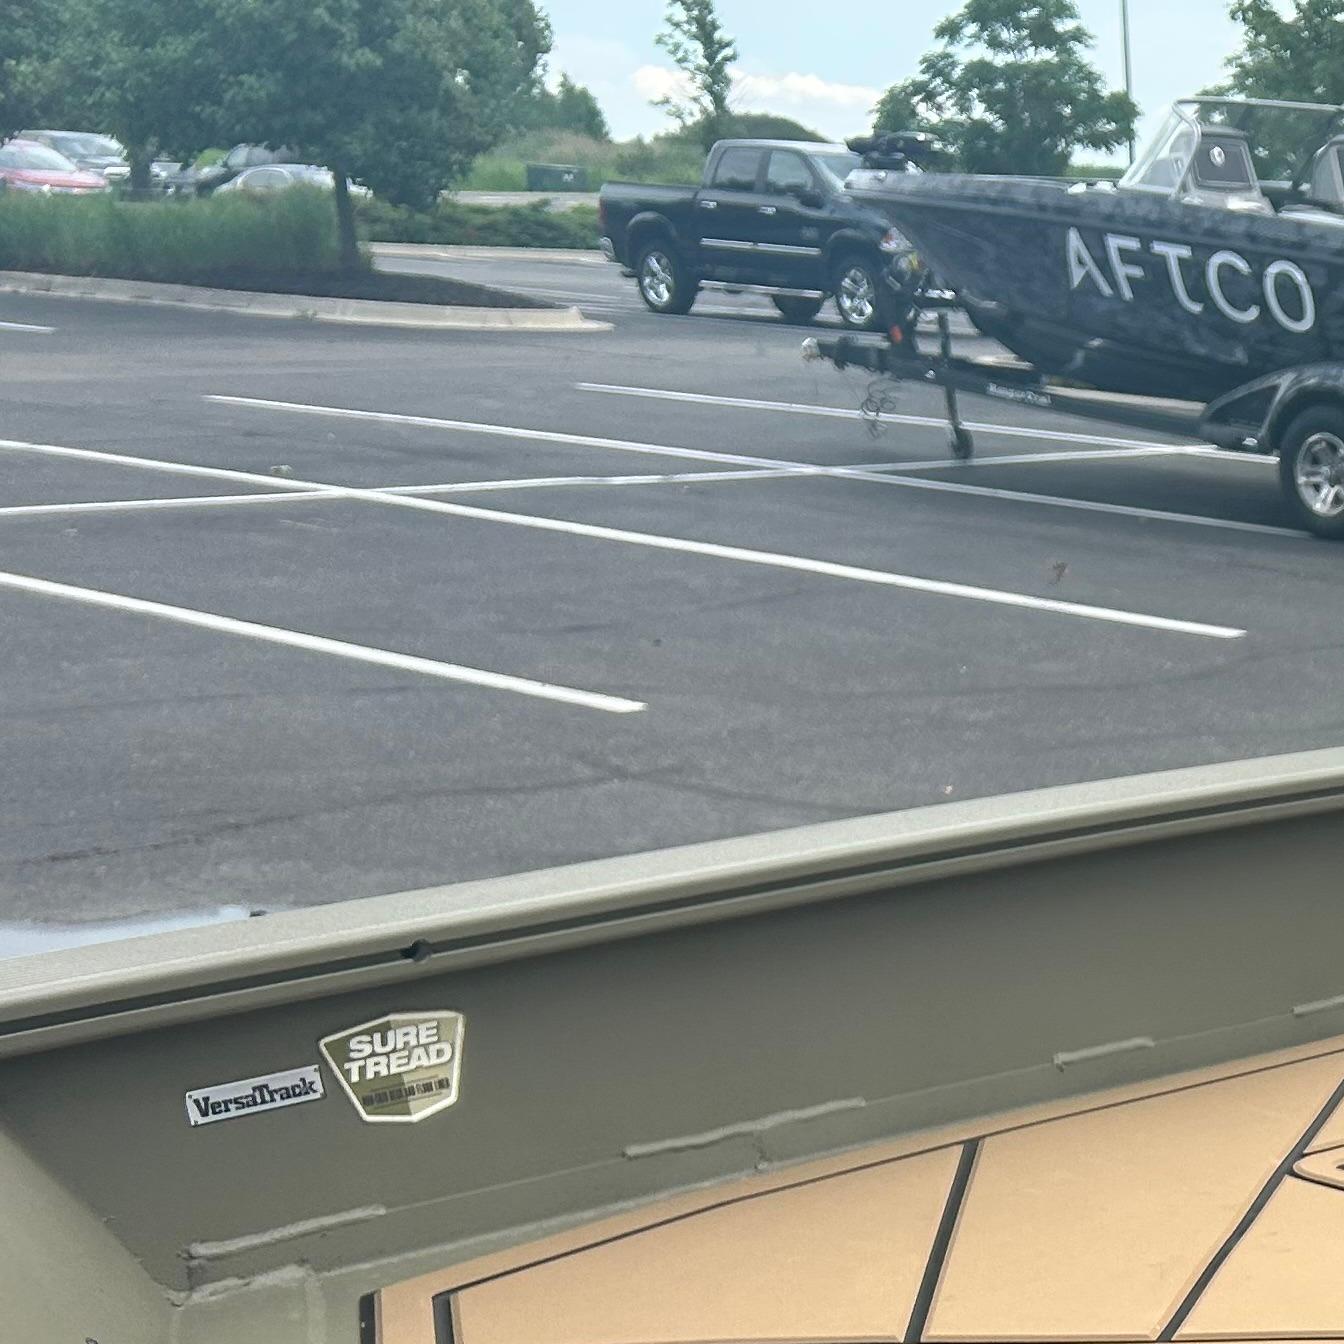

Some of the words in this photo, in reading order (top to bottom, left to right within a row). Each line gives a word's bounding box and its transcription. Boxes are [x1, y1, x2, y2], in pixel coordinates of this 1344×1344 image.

[1065, 226, 1316, 333] AFTCO
[348, 1020, 439, 1059] SURE
[343, 1041, 453, 1083] TREAD
[193, 1077, 319, 1118] VersaTrack
